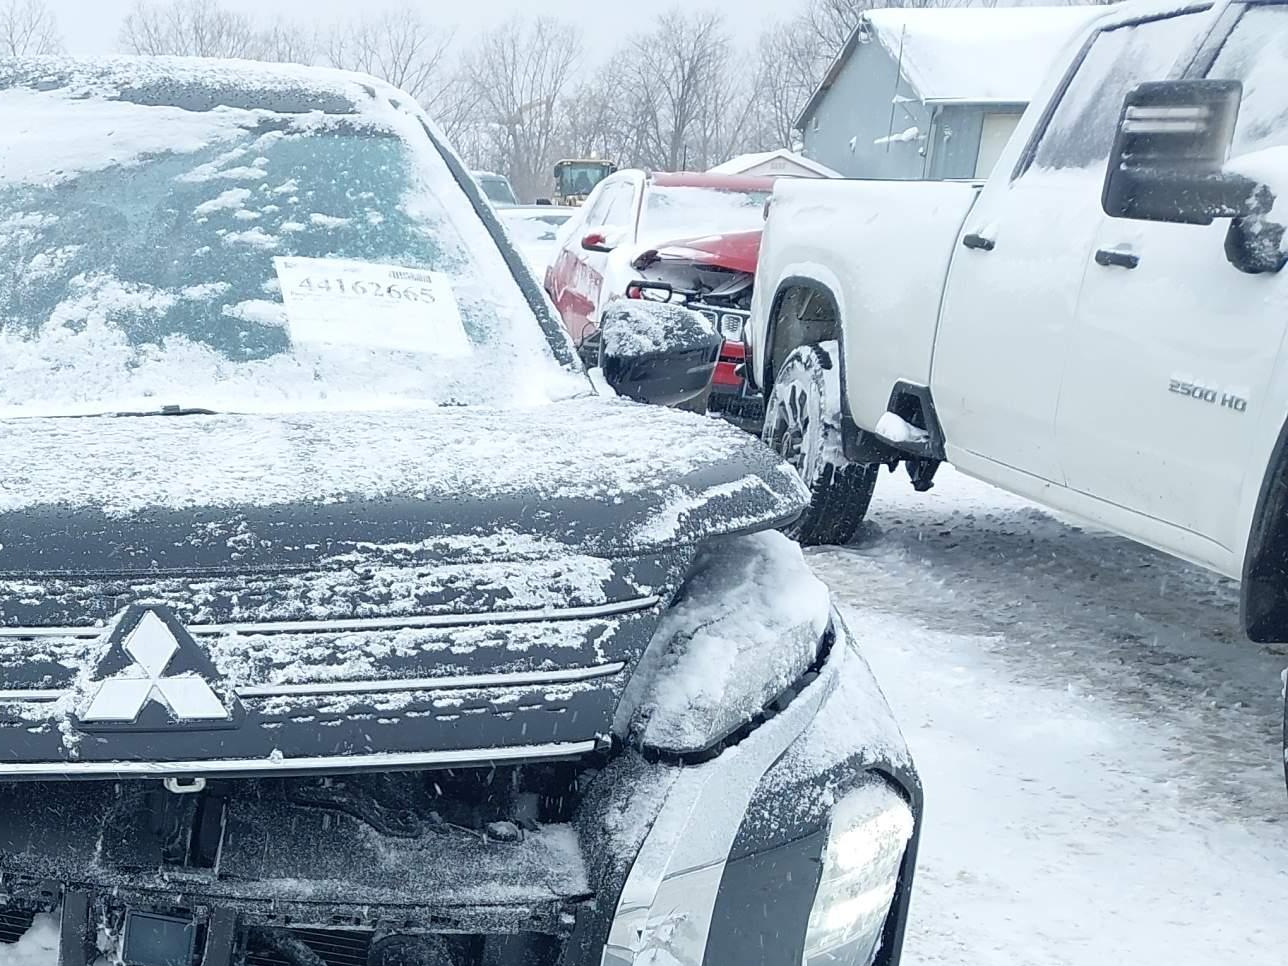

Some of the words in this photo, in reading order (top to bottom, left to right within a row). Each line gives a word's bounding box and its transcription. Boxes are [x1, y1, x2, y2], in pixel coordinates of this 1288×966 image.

[298, 277, 436, 304] 44162665
[1168, 379, 1217, 403] 2500
[1221, 392, 1248, 413] HD
